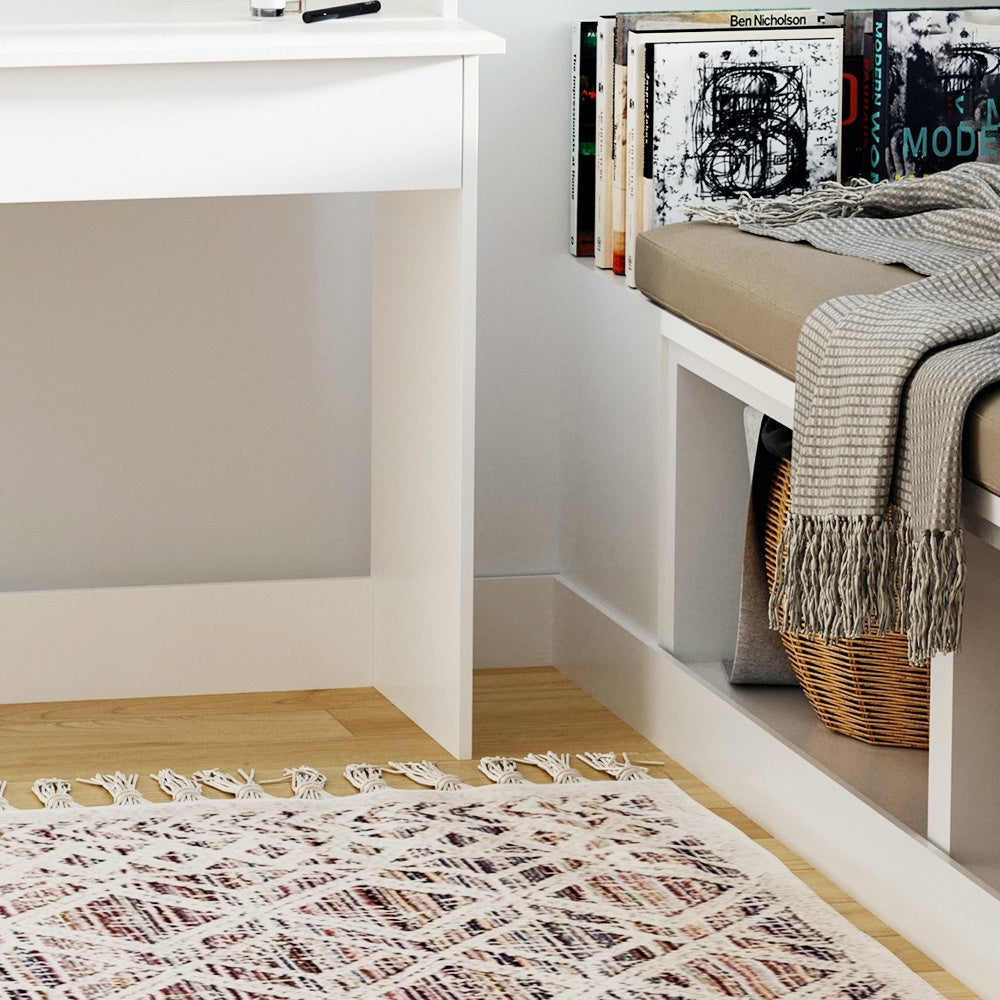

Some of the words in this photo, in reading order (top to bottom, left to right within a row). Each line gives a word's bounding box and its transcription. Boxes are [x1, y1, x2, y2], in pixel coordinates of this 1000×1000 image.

[729, 14, 752, 27] Ben
[754, 13, 807, 26] Nicholson
[873, 22, 883, 107] MODERN
